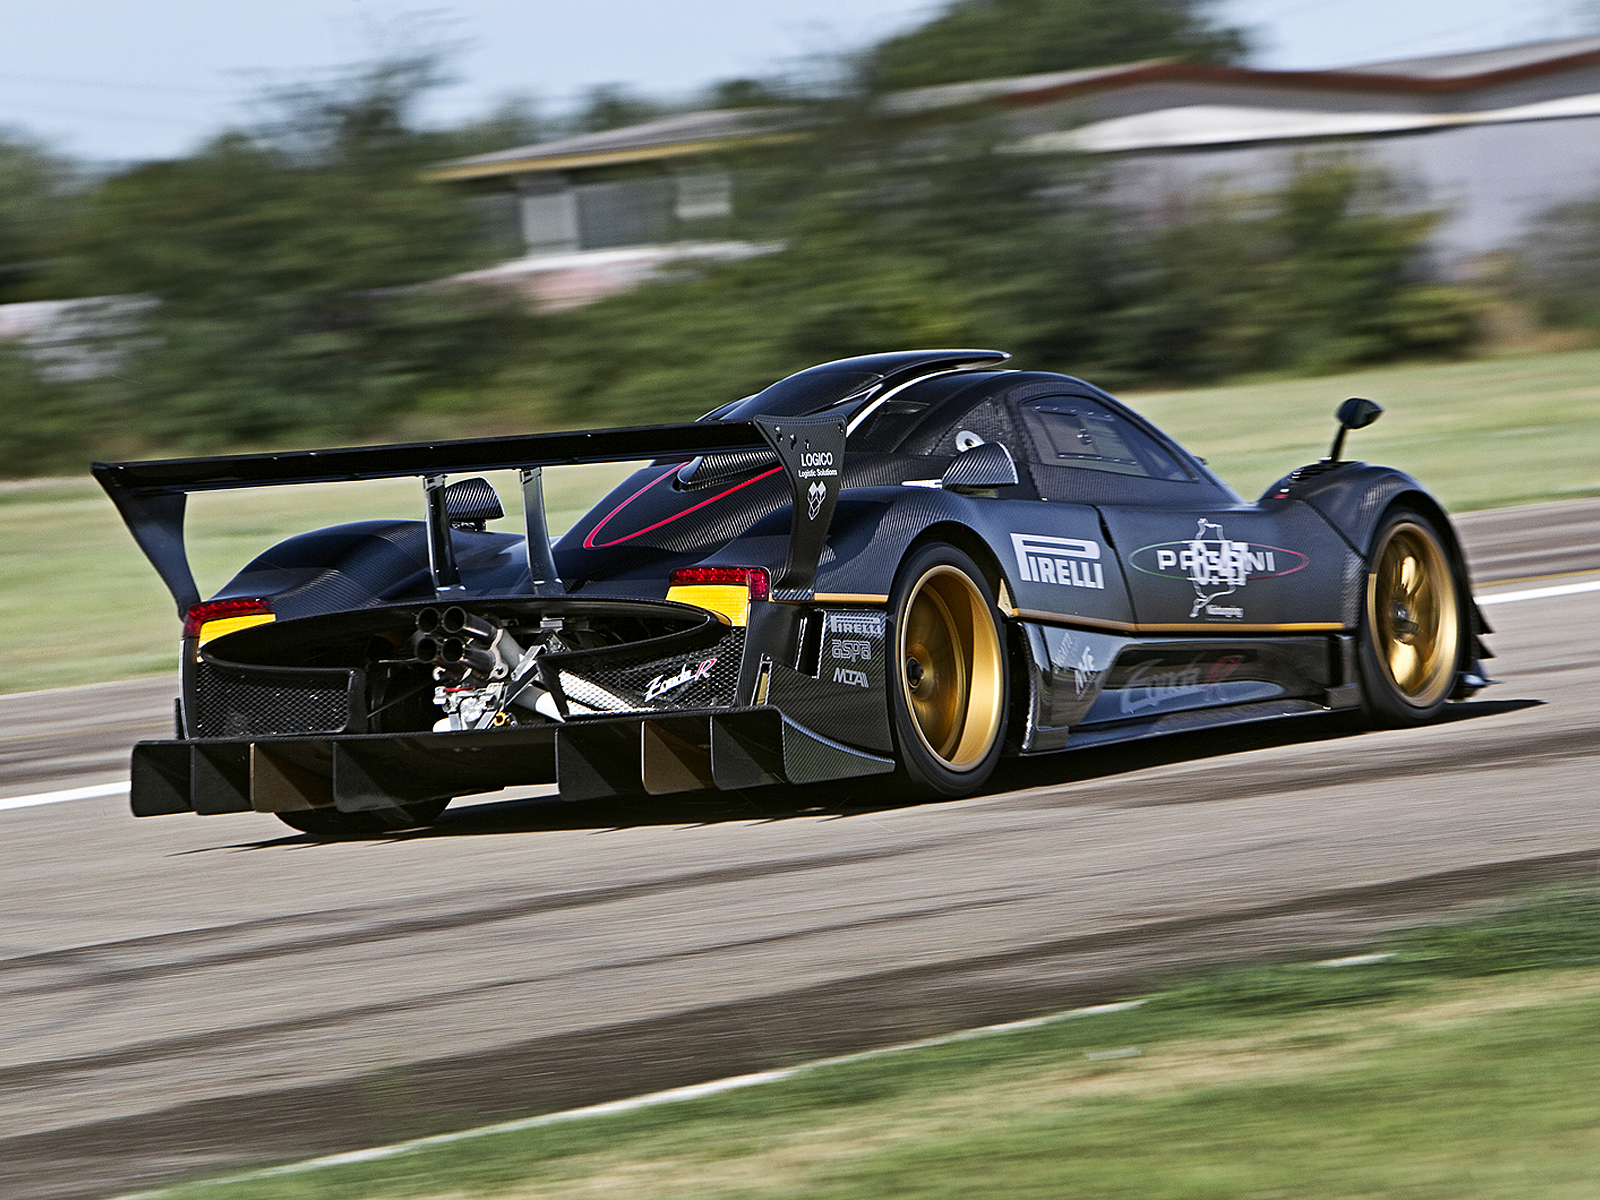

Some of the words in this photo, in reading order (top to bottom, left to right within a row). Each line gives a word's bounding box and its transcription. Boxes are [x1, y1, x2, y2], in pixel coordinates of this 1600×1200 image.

[800, 452, 833, 467] LOGICO
[798, 469, 816, 479] Logistic
[816, 468, 838, 477] Solutions
[1010, 533, 1104, 589] PIRELLI
[830, 615, 882, 635] PIRELLI
[831, 639, 872, 662] aspa
[694, 658, 718, 681] R
